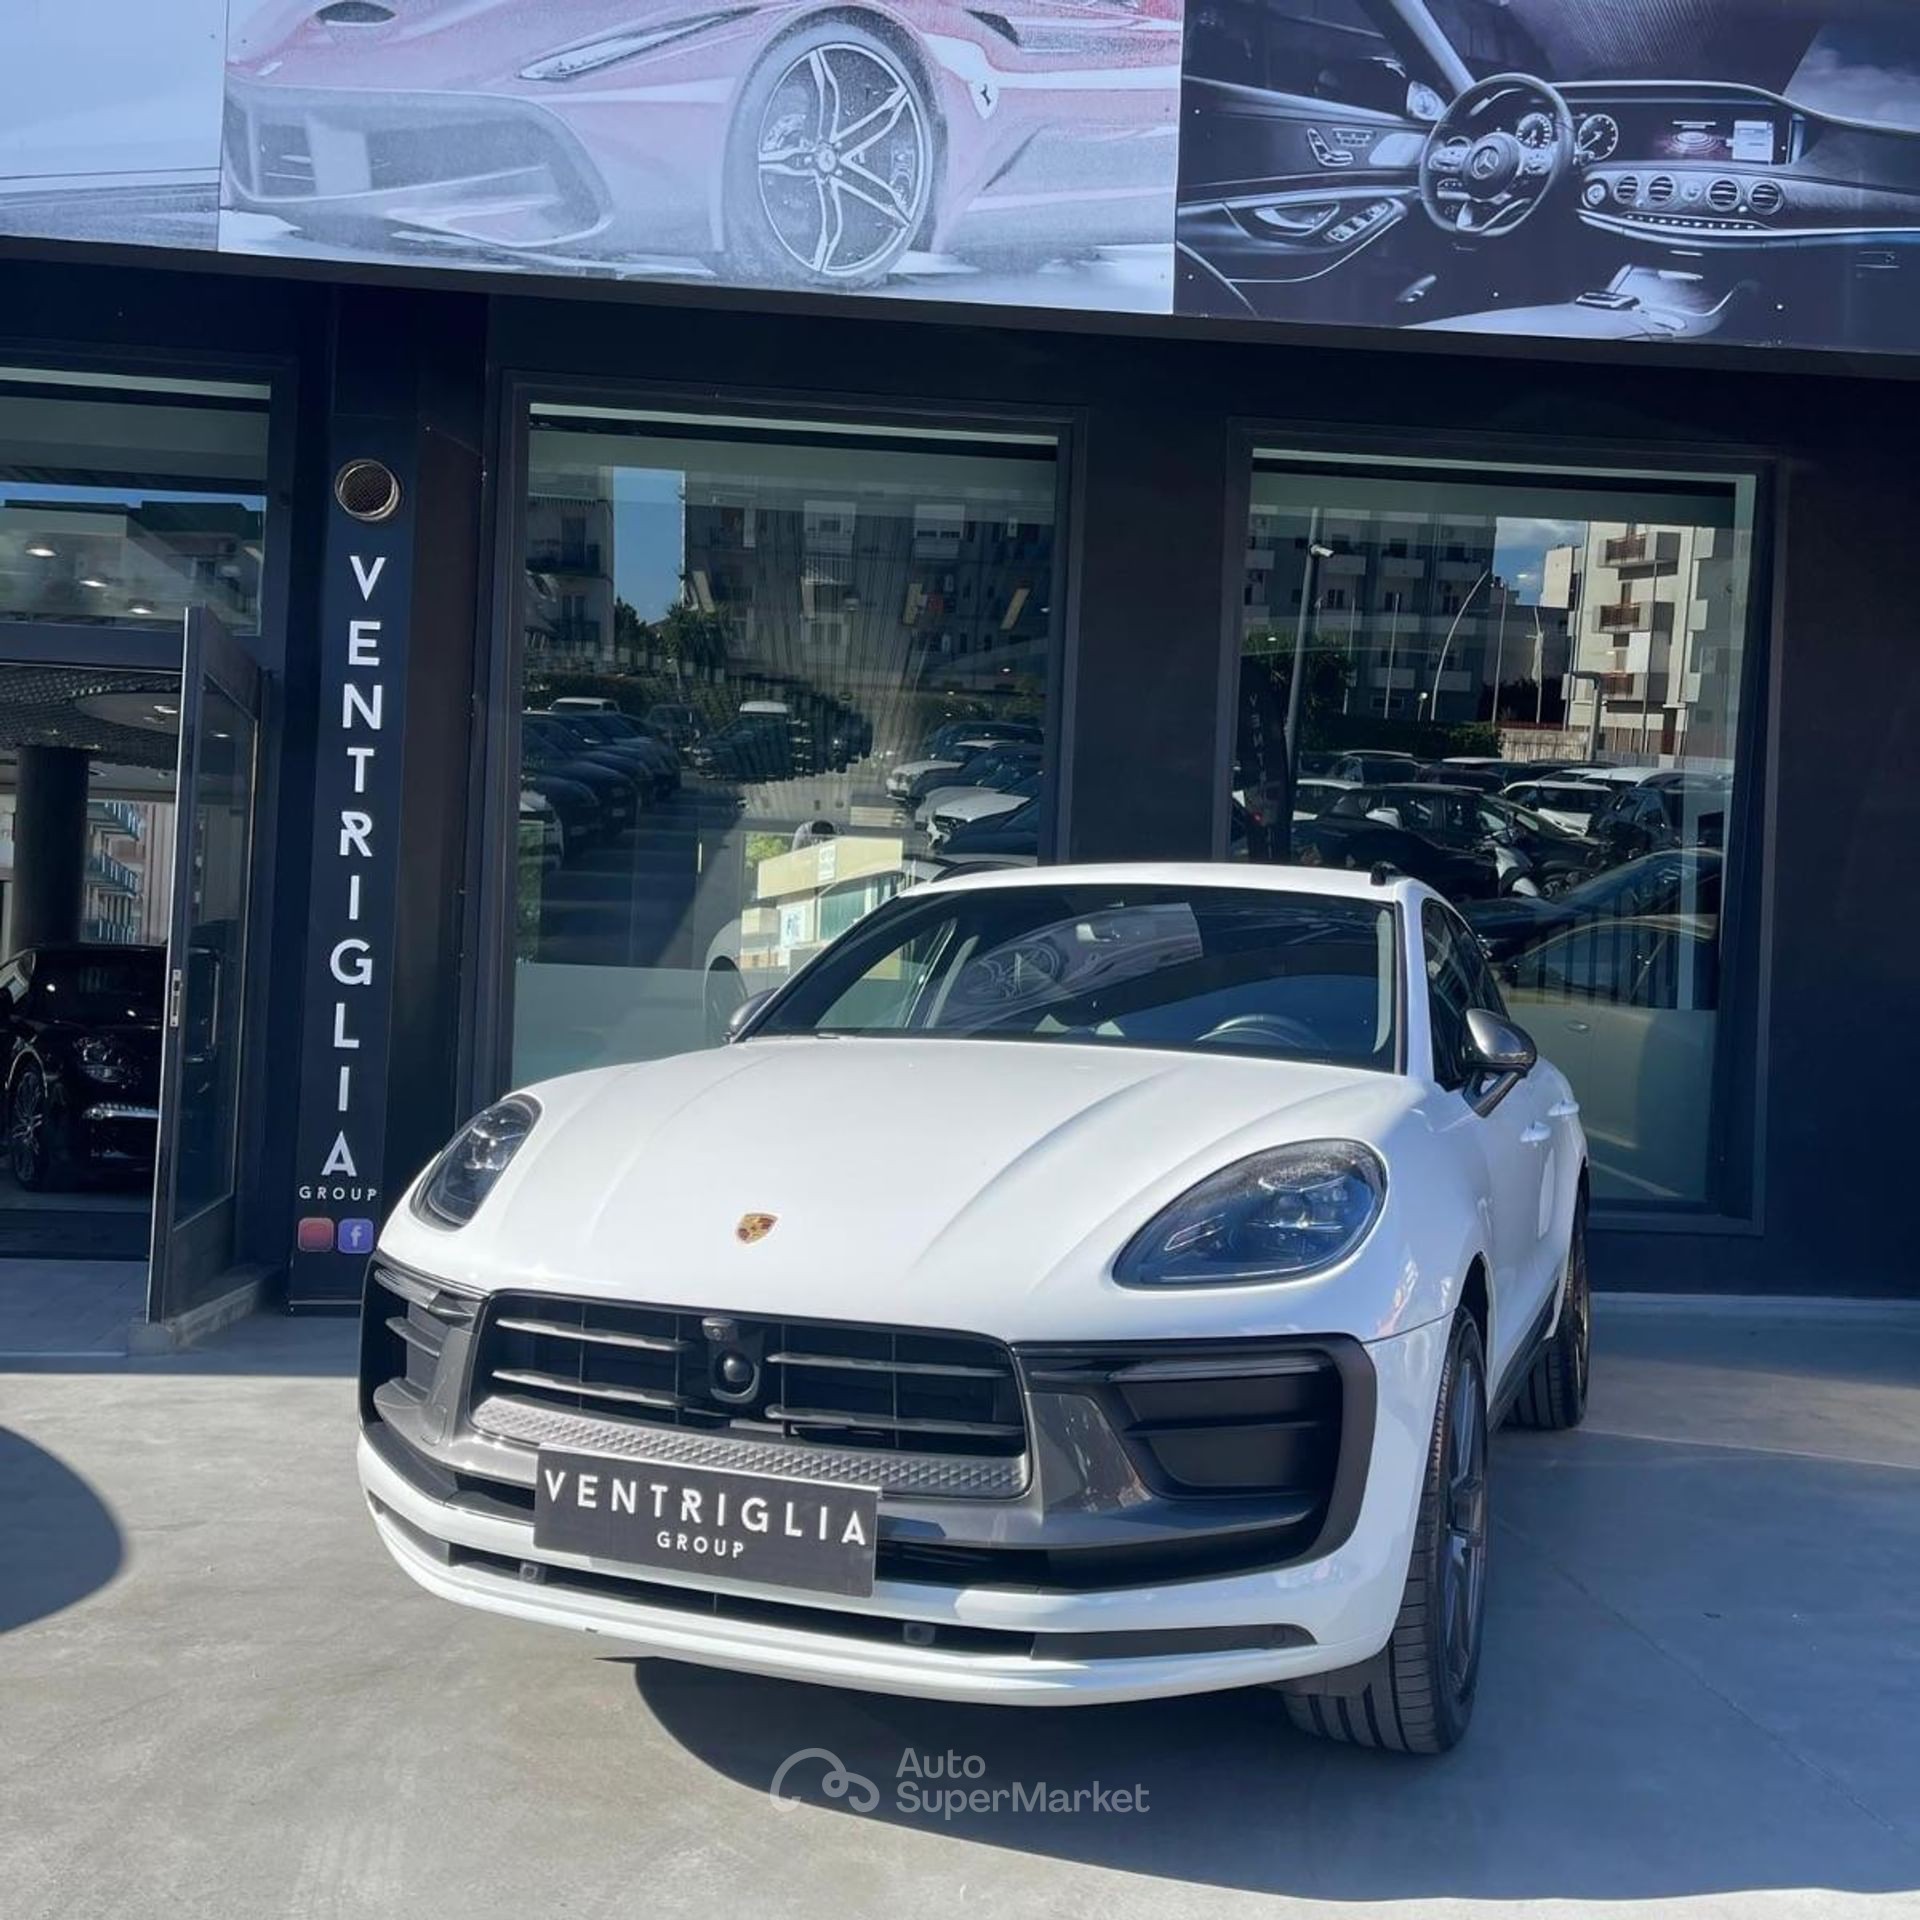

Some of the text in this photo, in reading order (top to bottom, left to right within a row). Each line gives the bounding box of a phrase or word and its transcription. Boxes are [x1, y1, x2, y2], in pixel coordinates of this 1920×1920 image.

[321, 555, 386, 1178] VENTRIGLIA
[299, 1185, 377, 1201] GROUP
[350, 1225, 362, 1247] f
[544, 1469, 866, 1546] VENTRIGLIA
[656, 1531, 745, 1558] GROUP
